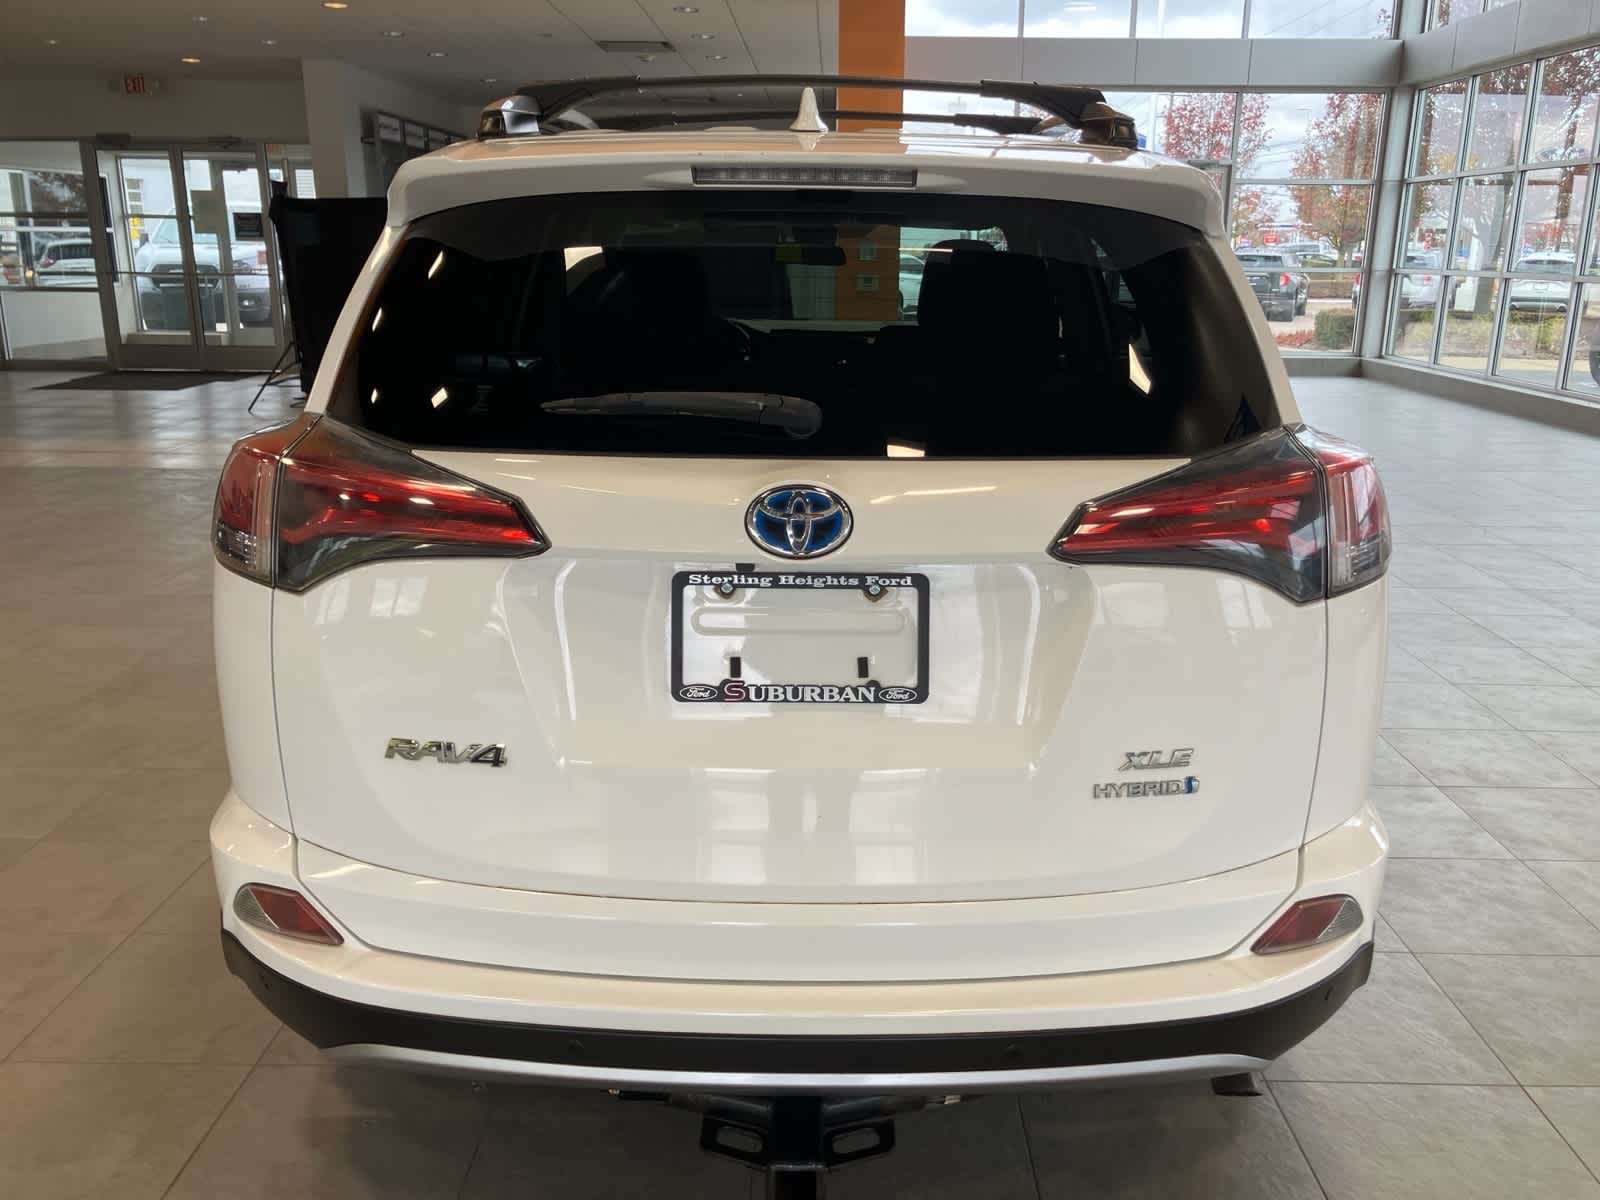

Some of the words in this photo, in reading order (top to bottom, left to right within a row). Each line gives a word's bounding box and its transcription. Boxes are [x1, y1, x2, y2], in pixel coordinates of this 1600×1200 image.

[688, 574, 773, 588] Sterling
[778, 575, 859, 588] Heights
[864, 575, 913, 586] Ford
[685, 686, 712, 699] Ford
[723, 682, 876, 703] SUBURBAN
[884, 688, 911, 701] Ford
[385, 737, 507, 768] RAV4
[1118, 748, 1195, 771] XLE
[1093, 779, 1184, 799] HYBRID
